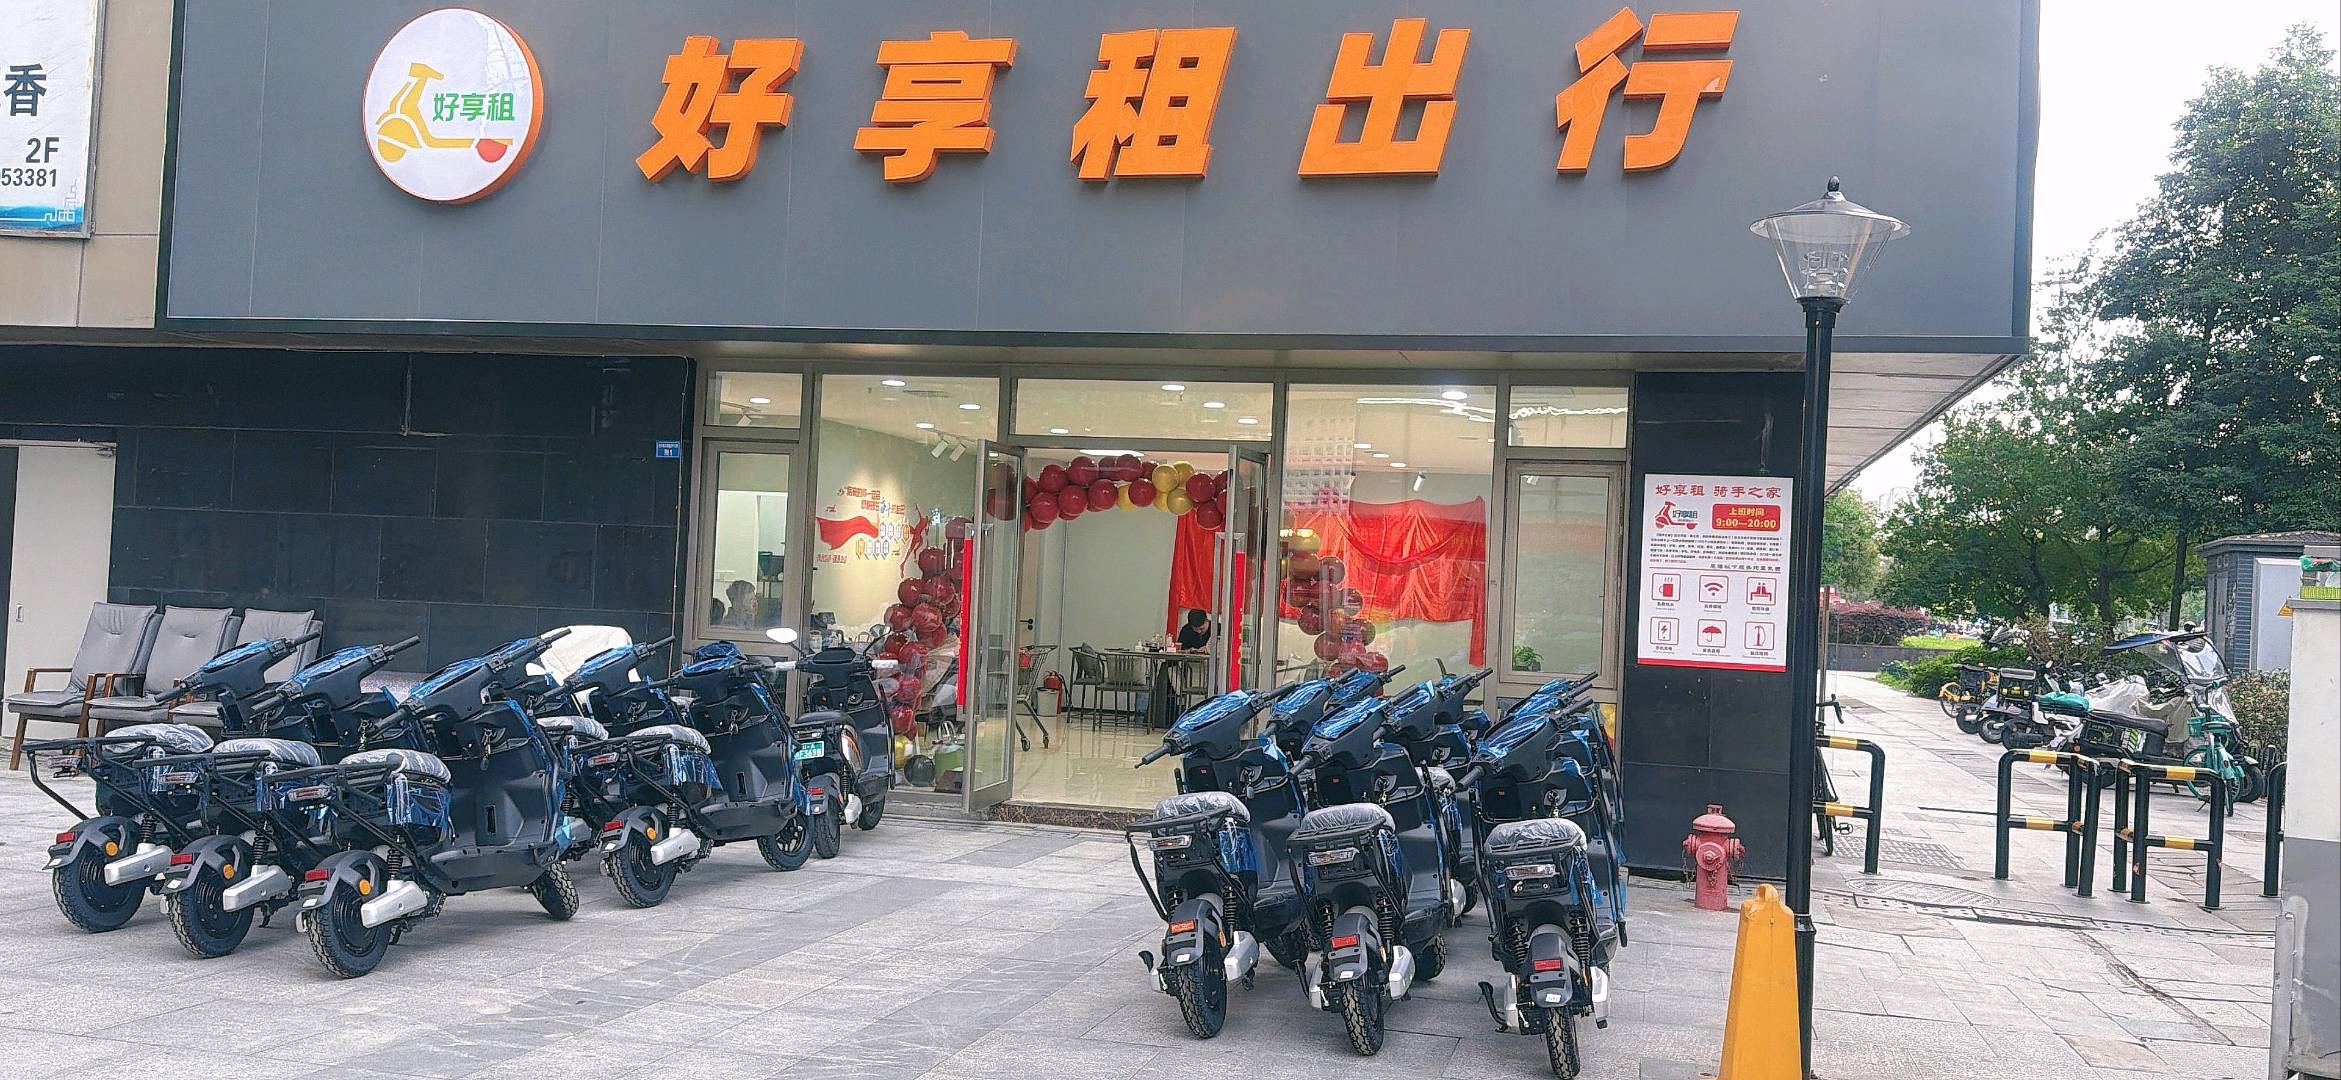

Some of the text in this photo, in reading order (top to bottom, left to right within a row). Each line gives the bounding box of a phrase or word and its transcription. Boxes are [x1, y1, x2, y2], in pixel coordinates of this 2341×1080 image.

[635, 6, 1740, 183] 好享租出行
[432, 92, 515, 122] 好享租
[25, 136, 60, 163] 2F
[0, 167, 57, 187] 53381
[1655, 483, 1782, 499] 好享租 骑手之家
[1728, 507, 1765, 517] 上班时间
